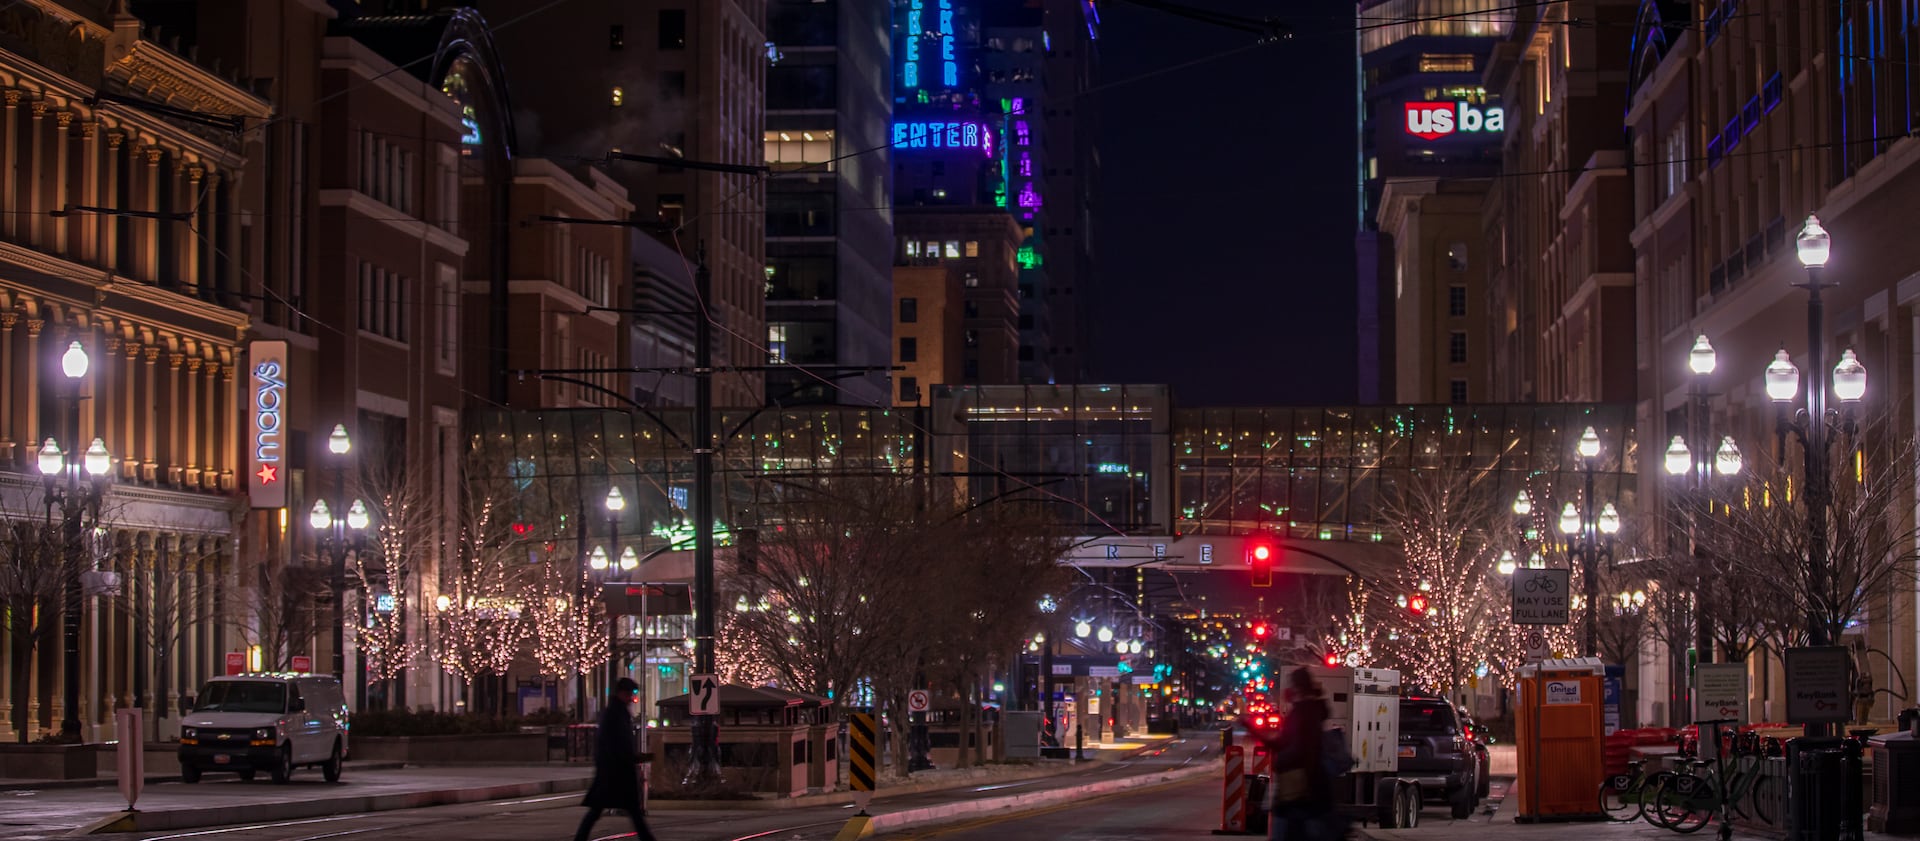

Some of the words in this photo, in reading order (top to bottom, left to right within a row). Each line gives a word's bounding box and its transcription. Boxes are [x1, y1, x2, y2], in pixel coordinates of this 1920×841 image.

[1458, 101, 1504, 132] ba
[892, 122, 978, 148] ENTER
[1517, 596, 1538, 605] MAY
[1543, 596, 1564, 606] USE
[1516, 609, 1538, 618] FULL
[1541, 609, 1565, 618] LANE
[1550, 685, 1577, 693] United
[1797, 690, 1838, 701] KeyBank
[1704, 699, 1738, 708] KeyBank
